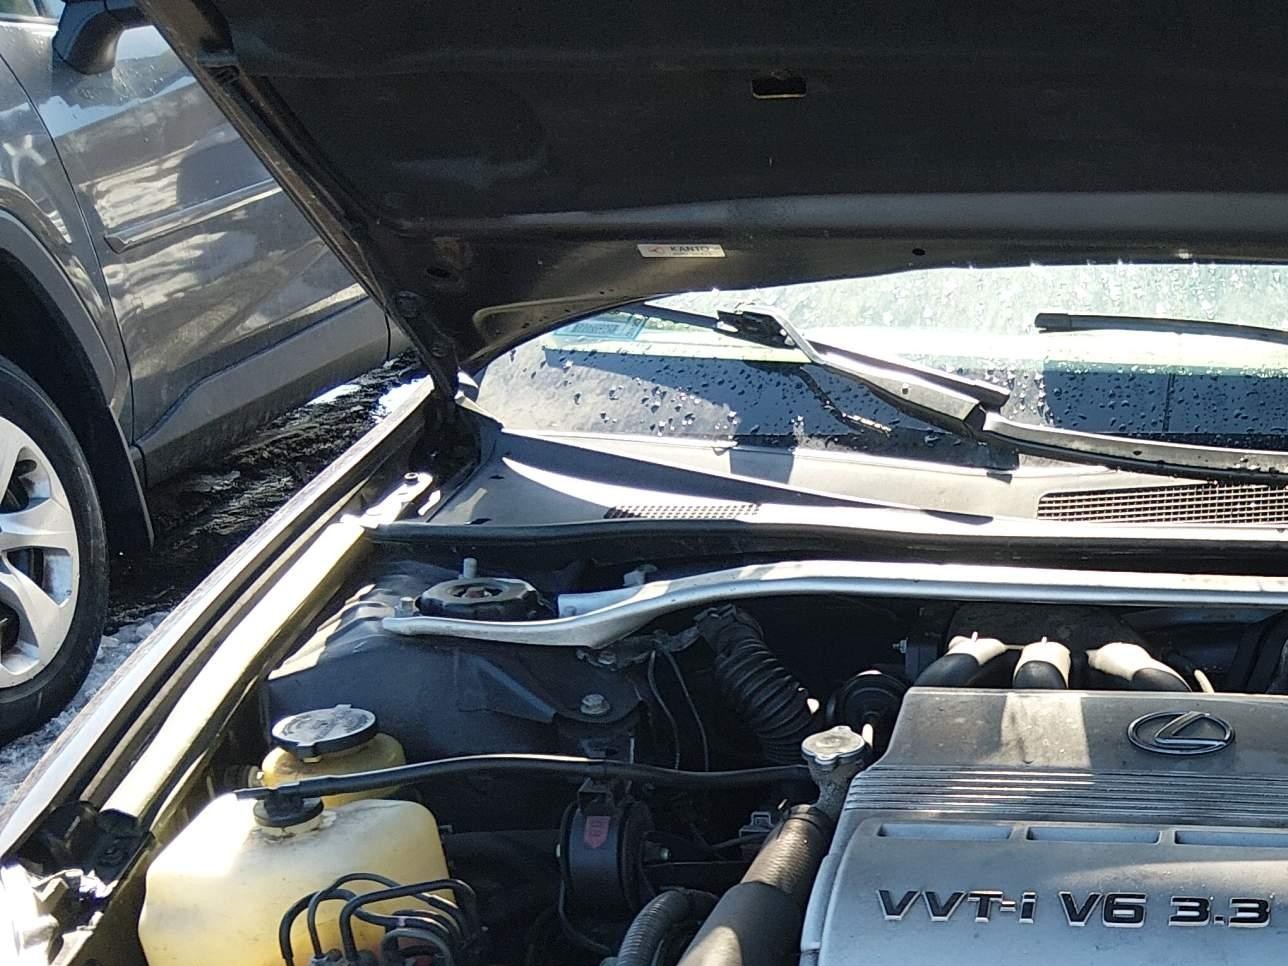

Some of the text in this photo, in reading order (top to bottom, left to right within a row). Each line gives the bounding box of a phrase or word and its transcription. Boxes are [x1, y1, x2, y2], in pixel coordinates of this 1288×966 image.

[877, 889, 1272, 928] VVT-i V6 3.3
